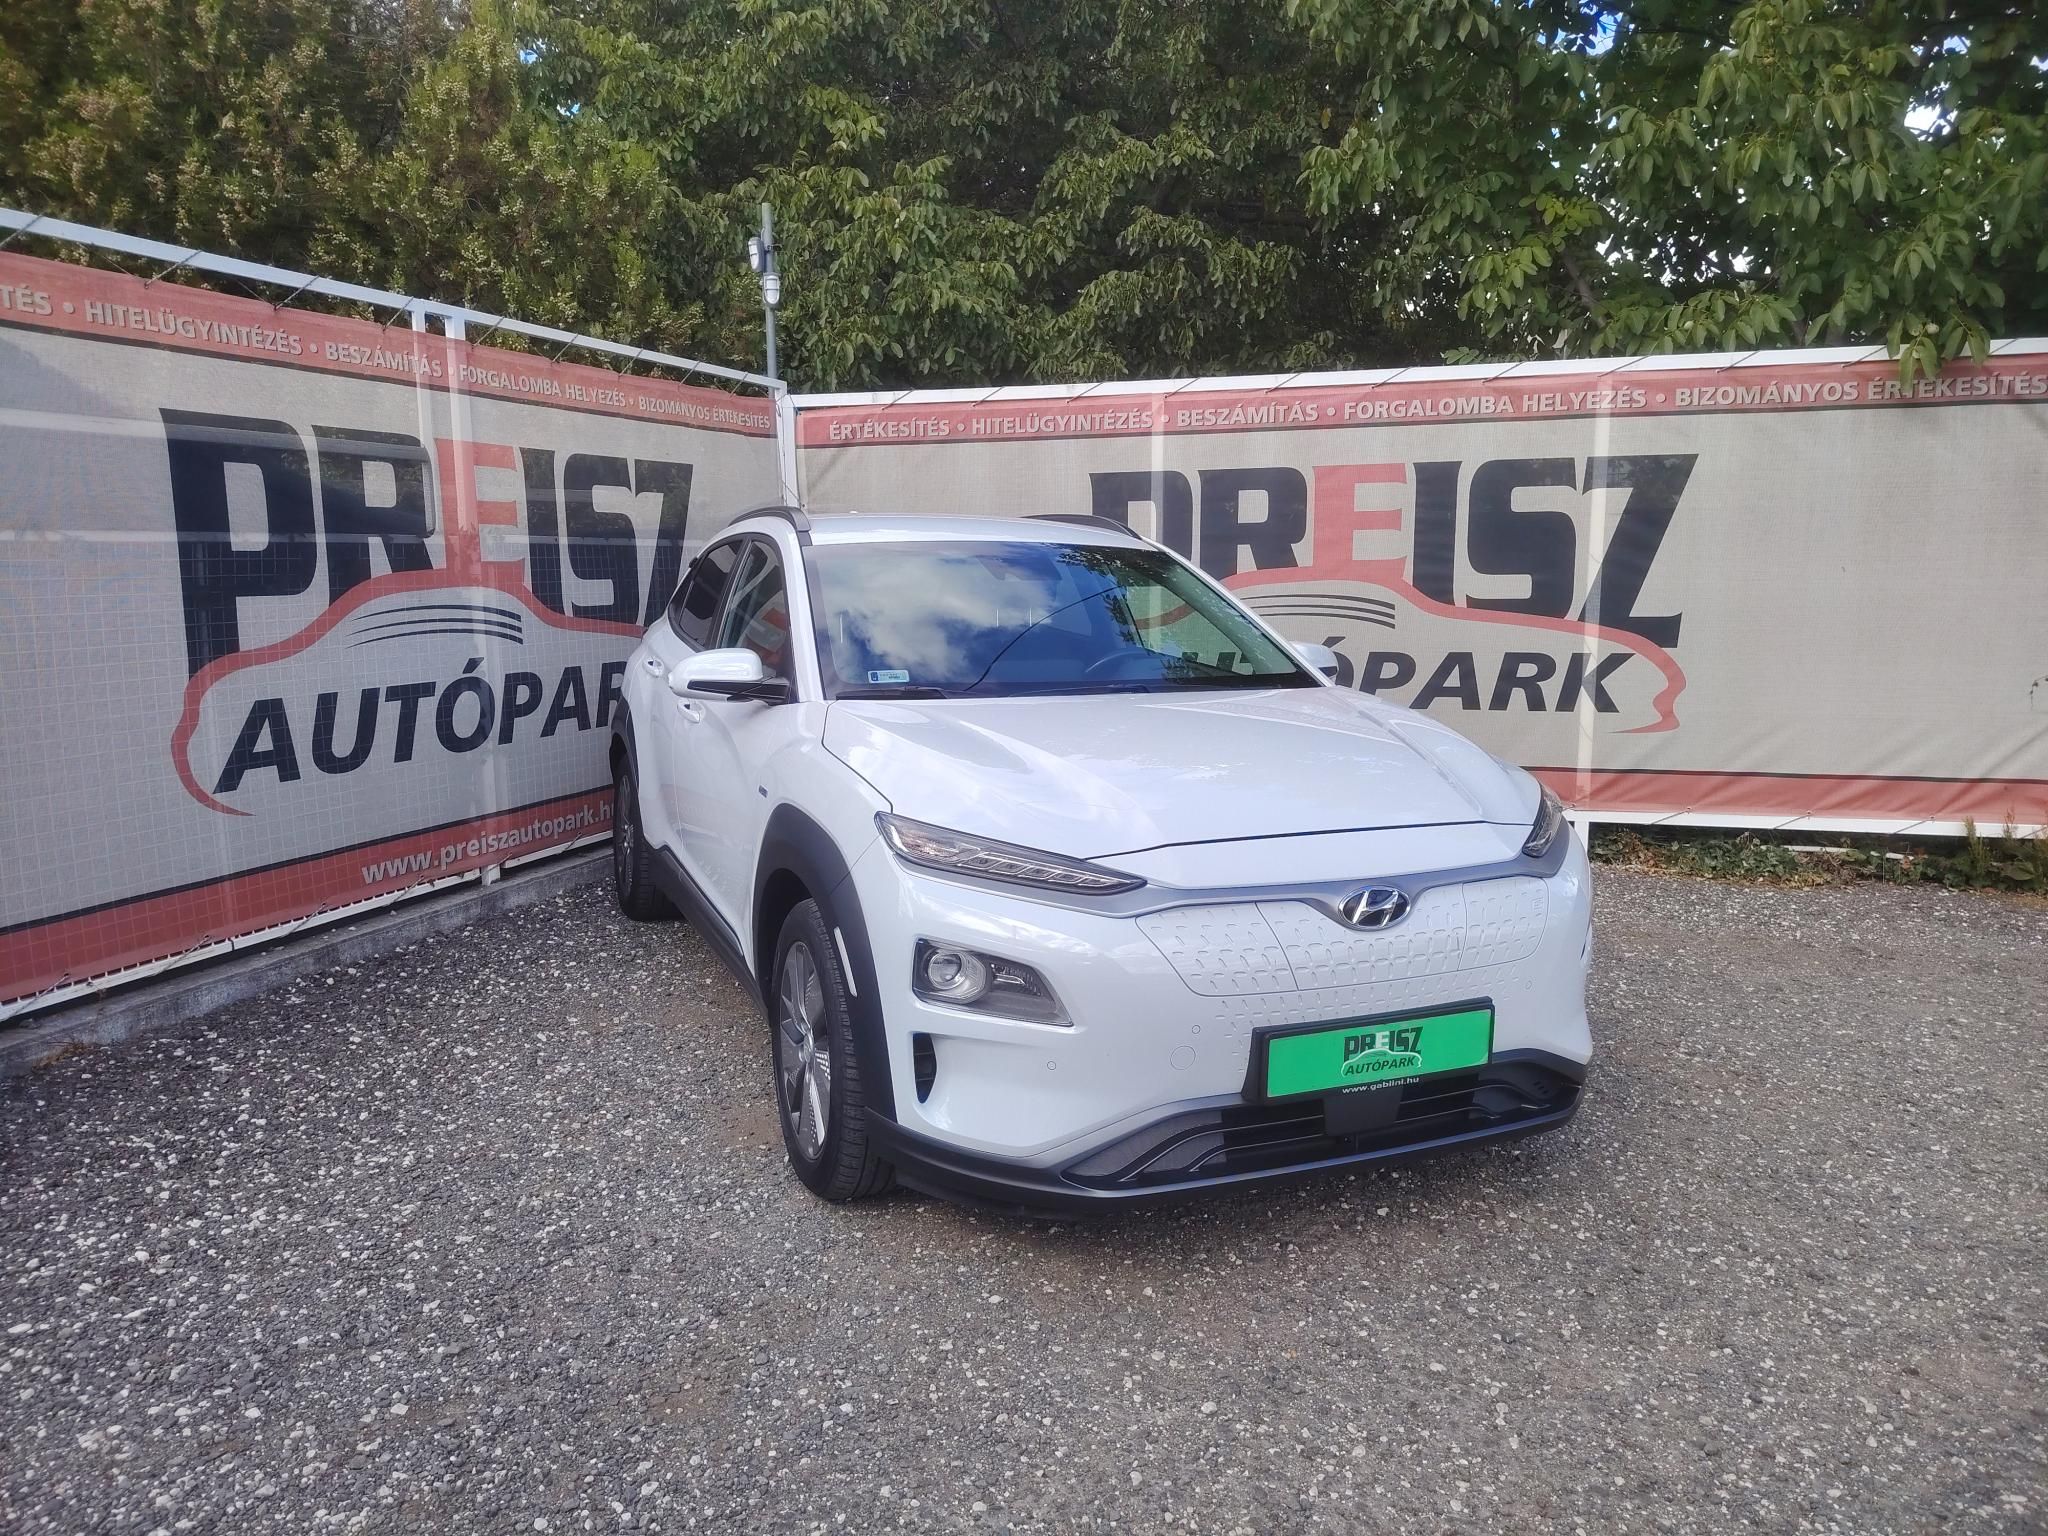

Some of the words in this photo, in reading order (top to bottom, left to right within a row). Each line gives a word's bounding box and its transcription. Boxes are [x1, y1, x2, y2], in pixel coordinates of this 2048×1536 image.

[85, 299, 303, 355] HITELÜGYINTÉZÉS
[325, 341, 443, 377] BESZÁMÍTÁS
[459, 364, 562, 398] FORGALOMBA
[565, 383, 626, 407] HELYEZÉS
[638, 395, 711, 421] BIZOMÁNYOS
[829, 418, 951, 442] ÉRTÉKESÍTÉS
[971, 407, 1154, 437] HITELÜGYINTÉZÉS
[1176, 401, 1319, 428] BESZÁMÍTÁS
[1344, 396, 1514, 421] FORGALOMBA
[1522, 385, 1648, 413] HELYEZÉS
[1675, 380, 1860, 408] BIZOMÁNYOS
[159, 407, 695, 681] PREISZ
[1090, 453, 1700, 650] PREISZ
[212, 656, 628, 796] AUTÓPAR
[361, 799, 614, 884] www.preiszautopark.h
[1341, 1077, 1420, 1094] www.gablini.hu
[1343, 1026, 1424, 1063] PREISZ
[1344, 1056, 1416, 1077] AUTÓPARK
